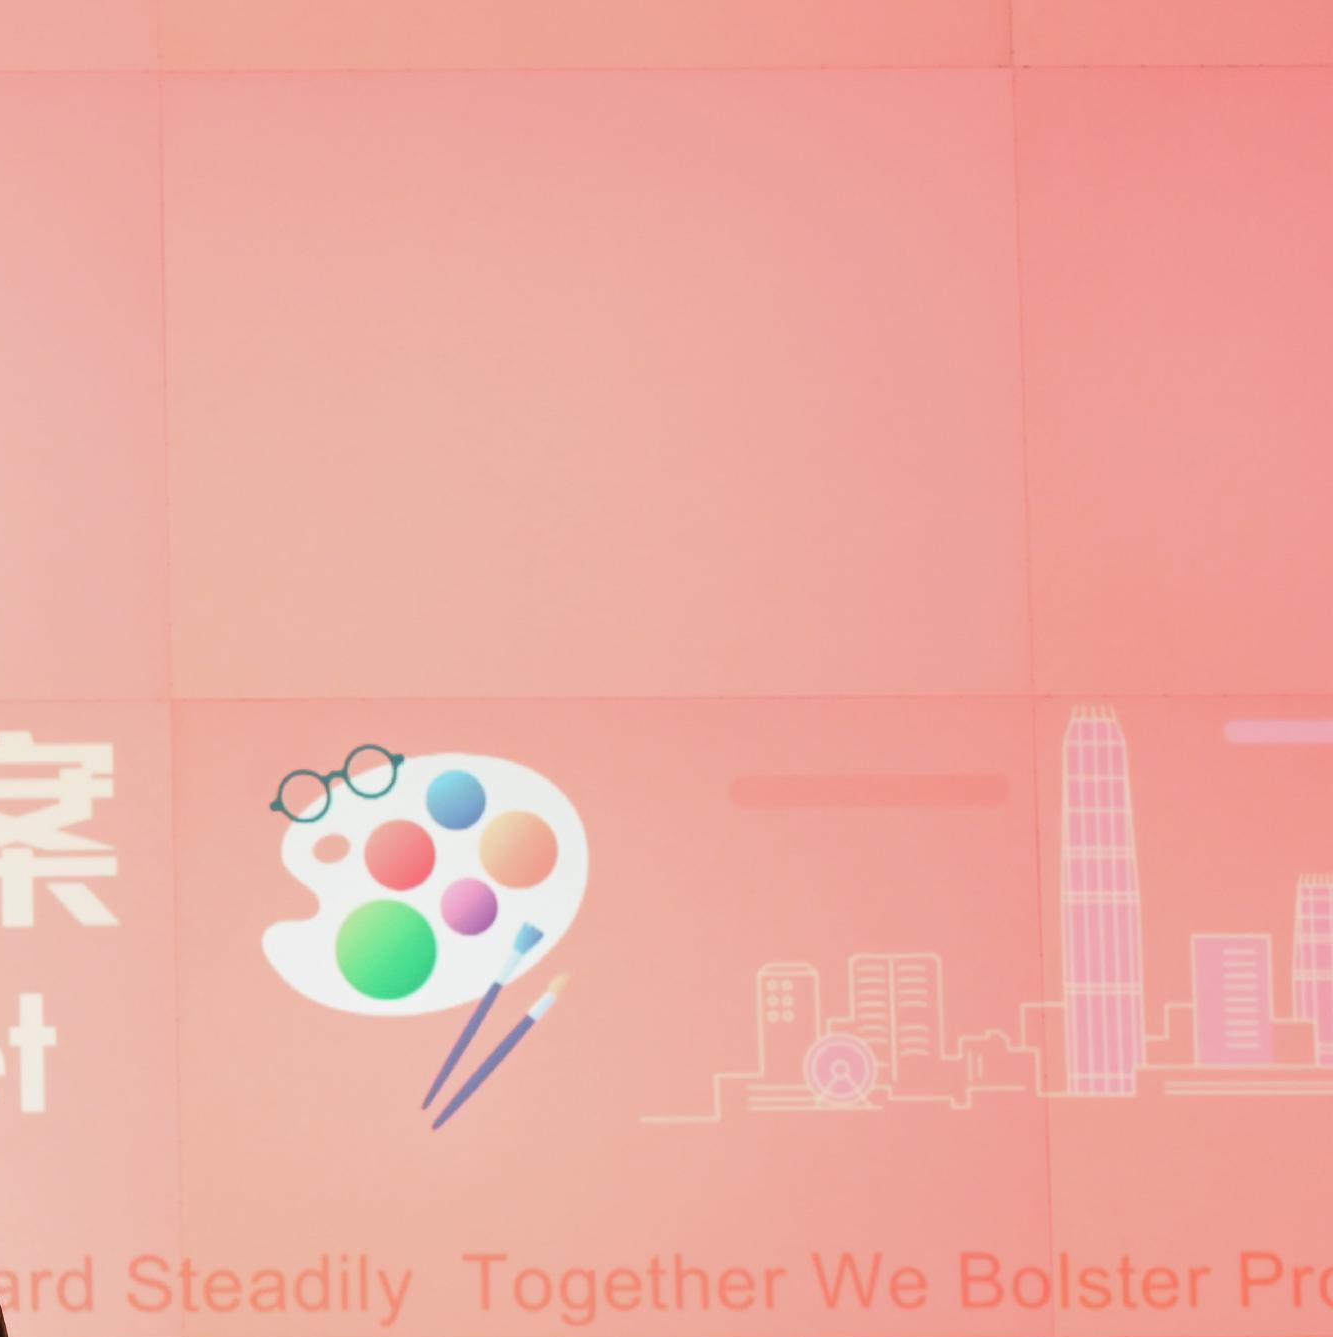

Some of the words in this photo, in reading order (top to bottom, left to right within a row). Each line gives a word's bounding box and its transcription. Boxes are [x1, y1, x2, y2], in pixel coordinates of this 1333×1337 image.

[127, 1254, 413, 1327] Steadily
[461, 1252, 786, 1326] Together
[811, 1252, 928, 1310] We
[959, 1251, 1212, 1310] Bolster
